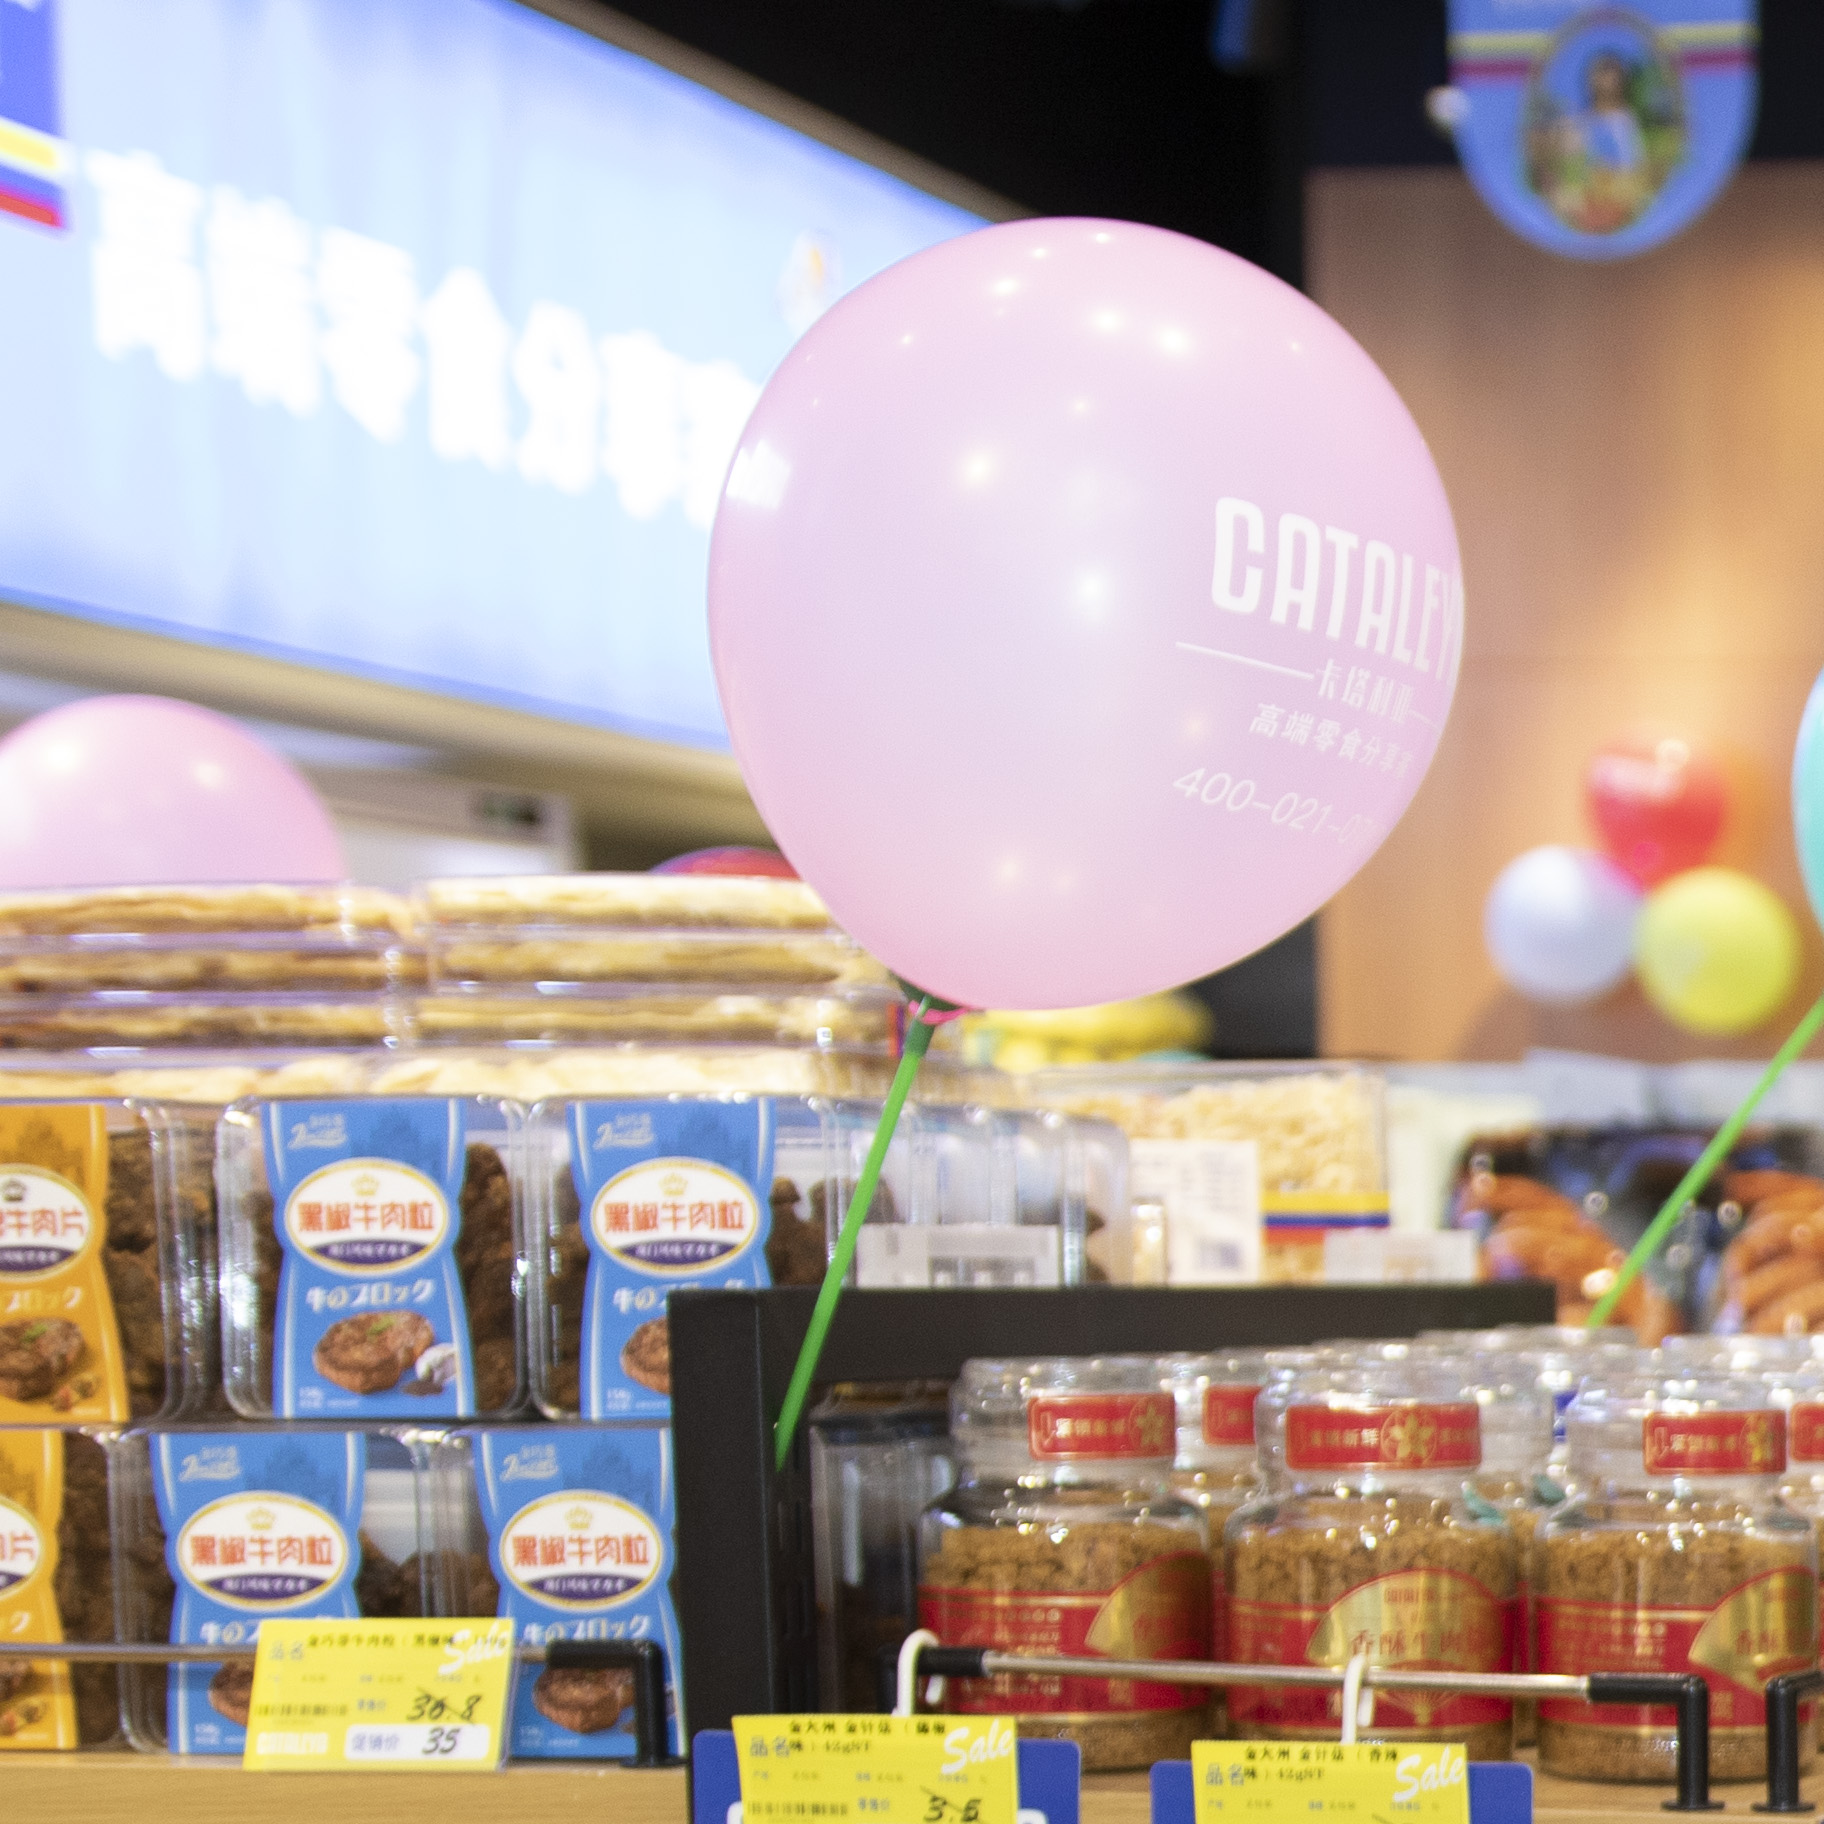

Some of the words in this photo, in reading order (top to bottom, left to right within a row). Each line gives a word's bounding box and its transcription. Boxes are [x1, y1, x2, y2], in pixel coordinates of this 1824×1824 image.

[297, 1201, 436, 1233] 黑椒牛肉粒
[189, 1534, 337, 1567] 黑椒牛肉粒
[511, 1533, 650, 1568] 黑椒牛肉粒
[437, 1621, 511, 1676] Sale
[422, 1726, 461, 1755] 35
[940, 1718, 1014, 1776] Sale
[1392, 1745, 1466, 1803] Sale
